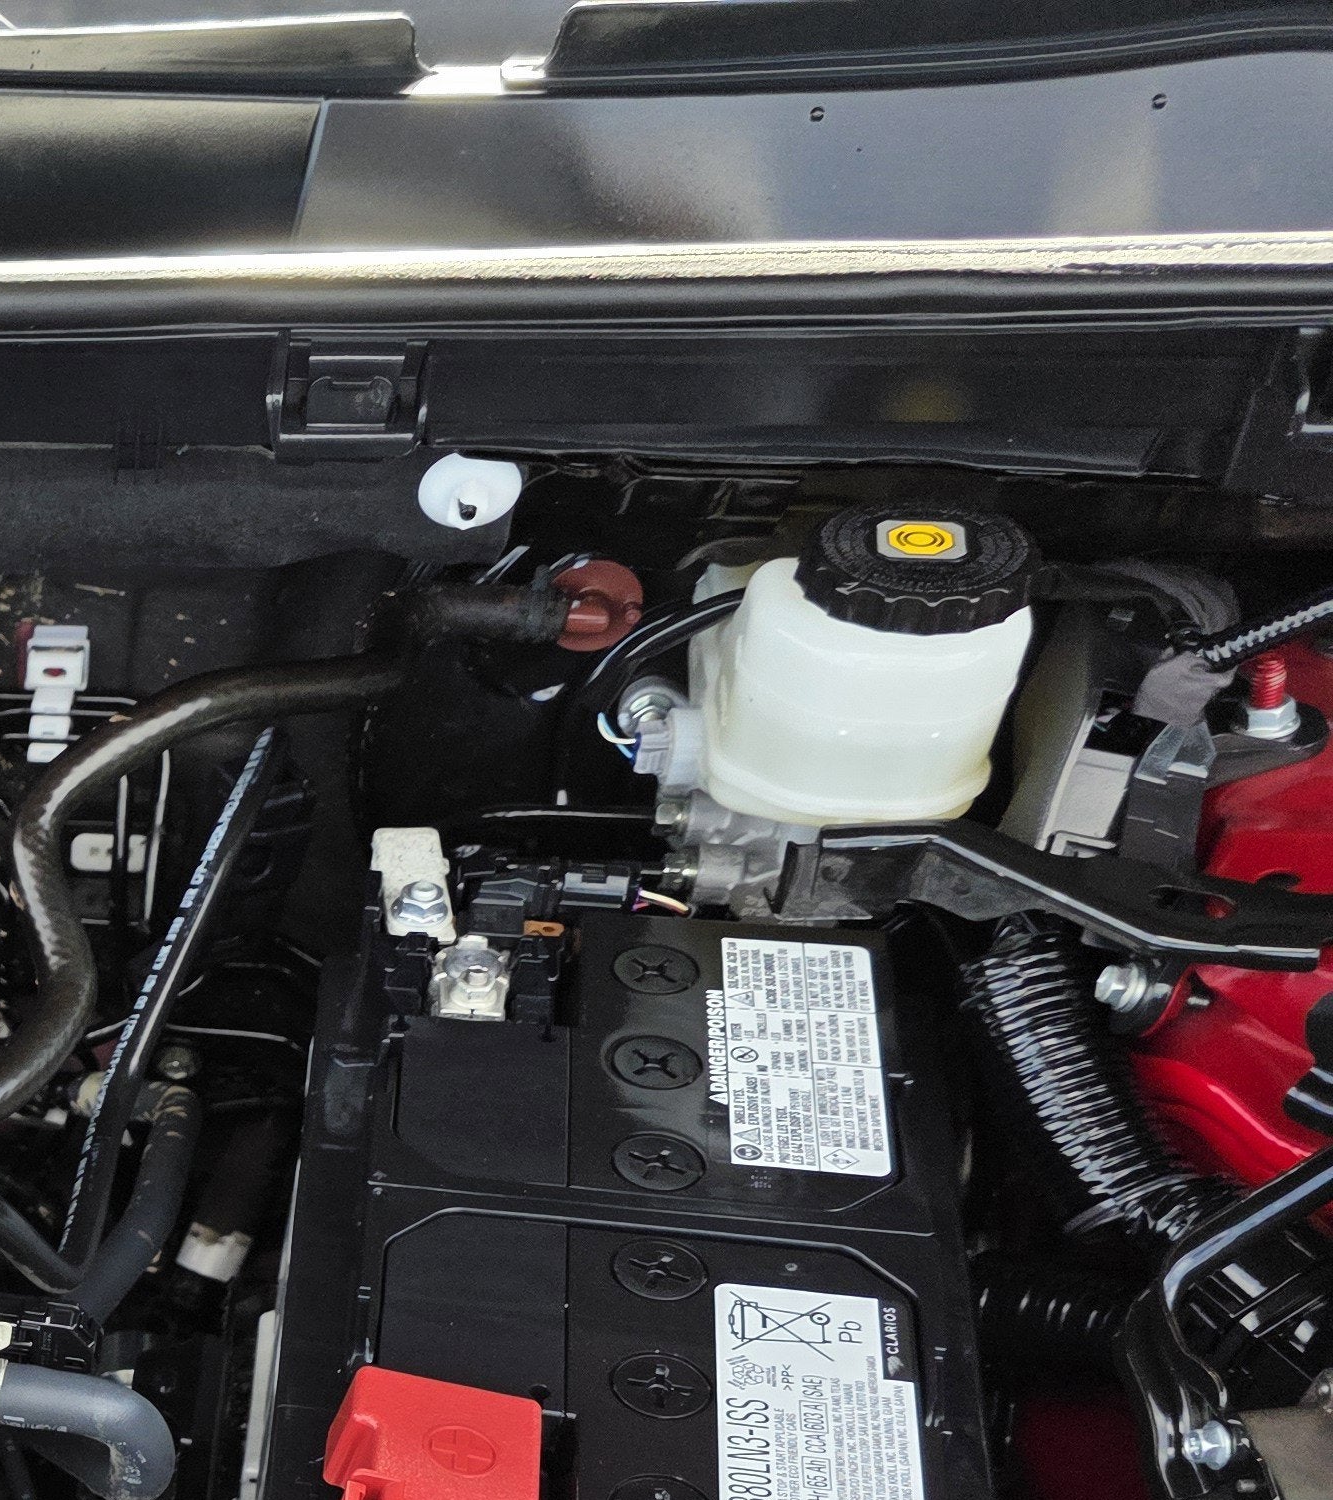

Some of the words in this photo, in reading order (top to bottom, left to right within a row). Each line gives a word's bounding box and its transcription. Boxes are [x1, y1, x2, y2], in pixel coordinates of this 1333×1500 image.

[705, 989, 727, 1091] DANGER/POISON
[838, 1320, 861, 1343] Pb
[882, 1306, 899, 1354] CLARIOS
[800, 1374, 828, 1400] (SAE)
[773, 1407, 785, 1448] APPLICABLE
[785, 1412, 797, 1431] CARS
[802, 1412, 825, 1430] 603
[786, 1432, 798, 1464] FRIENDLY
[803, 1432, 826, 1453] CCA
[775, 1449, 786, 1470] START
[805, 1459, 827, 1473] Ah
[787, 1465, 799, 1478] ECO
[805, 1474, 828, 1487] 65
[776, 1478, 787, 1497] STOP
